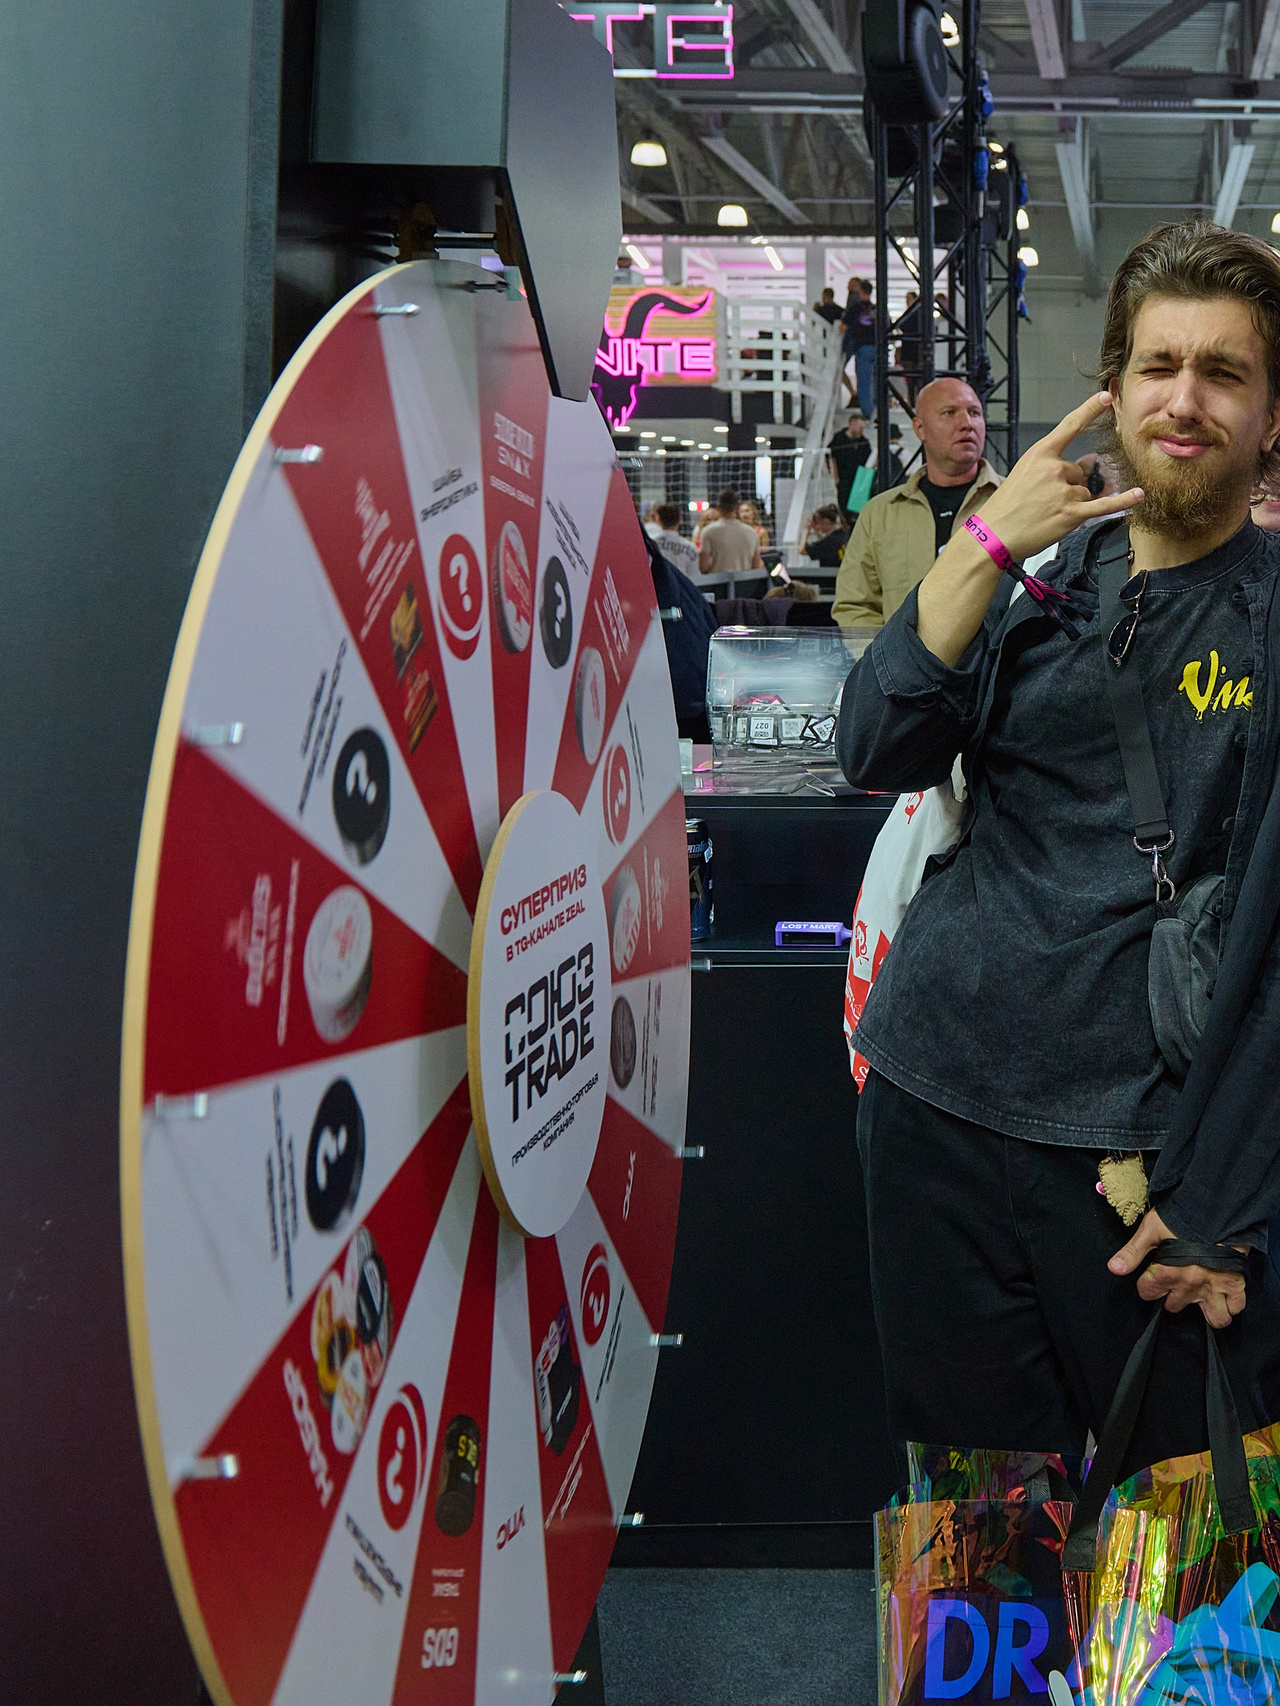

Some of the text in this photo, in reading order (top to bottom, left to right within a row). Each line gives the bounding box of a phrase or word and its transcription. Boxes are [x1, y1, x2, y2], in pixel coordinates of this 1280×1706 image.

[755, 722, 769, 730] 027
[500, 864, 587, 935] СУПЕРПРИЗ
[506, 899, 586, 962] В TG-КАНАЛЕ ZEAL
[505, 942, 594, 1065] СОЮЗ
[505, 1000, 594, 1123] TRADE
[542, 1112, 576, 1151] КОМПАНИЯ
[421, 1626, 459, 1669] GDS
[924, 1599, 1085, 1700] DR
